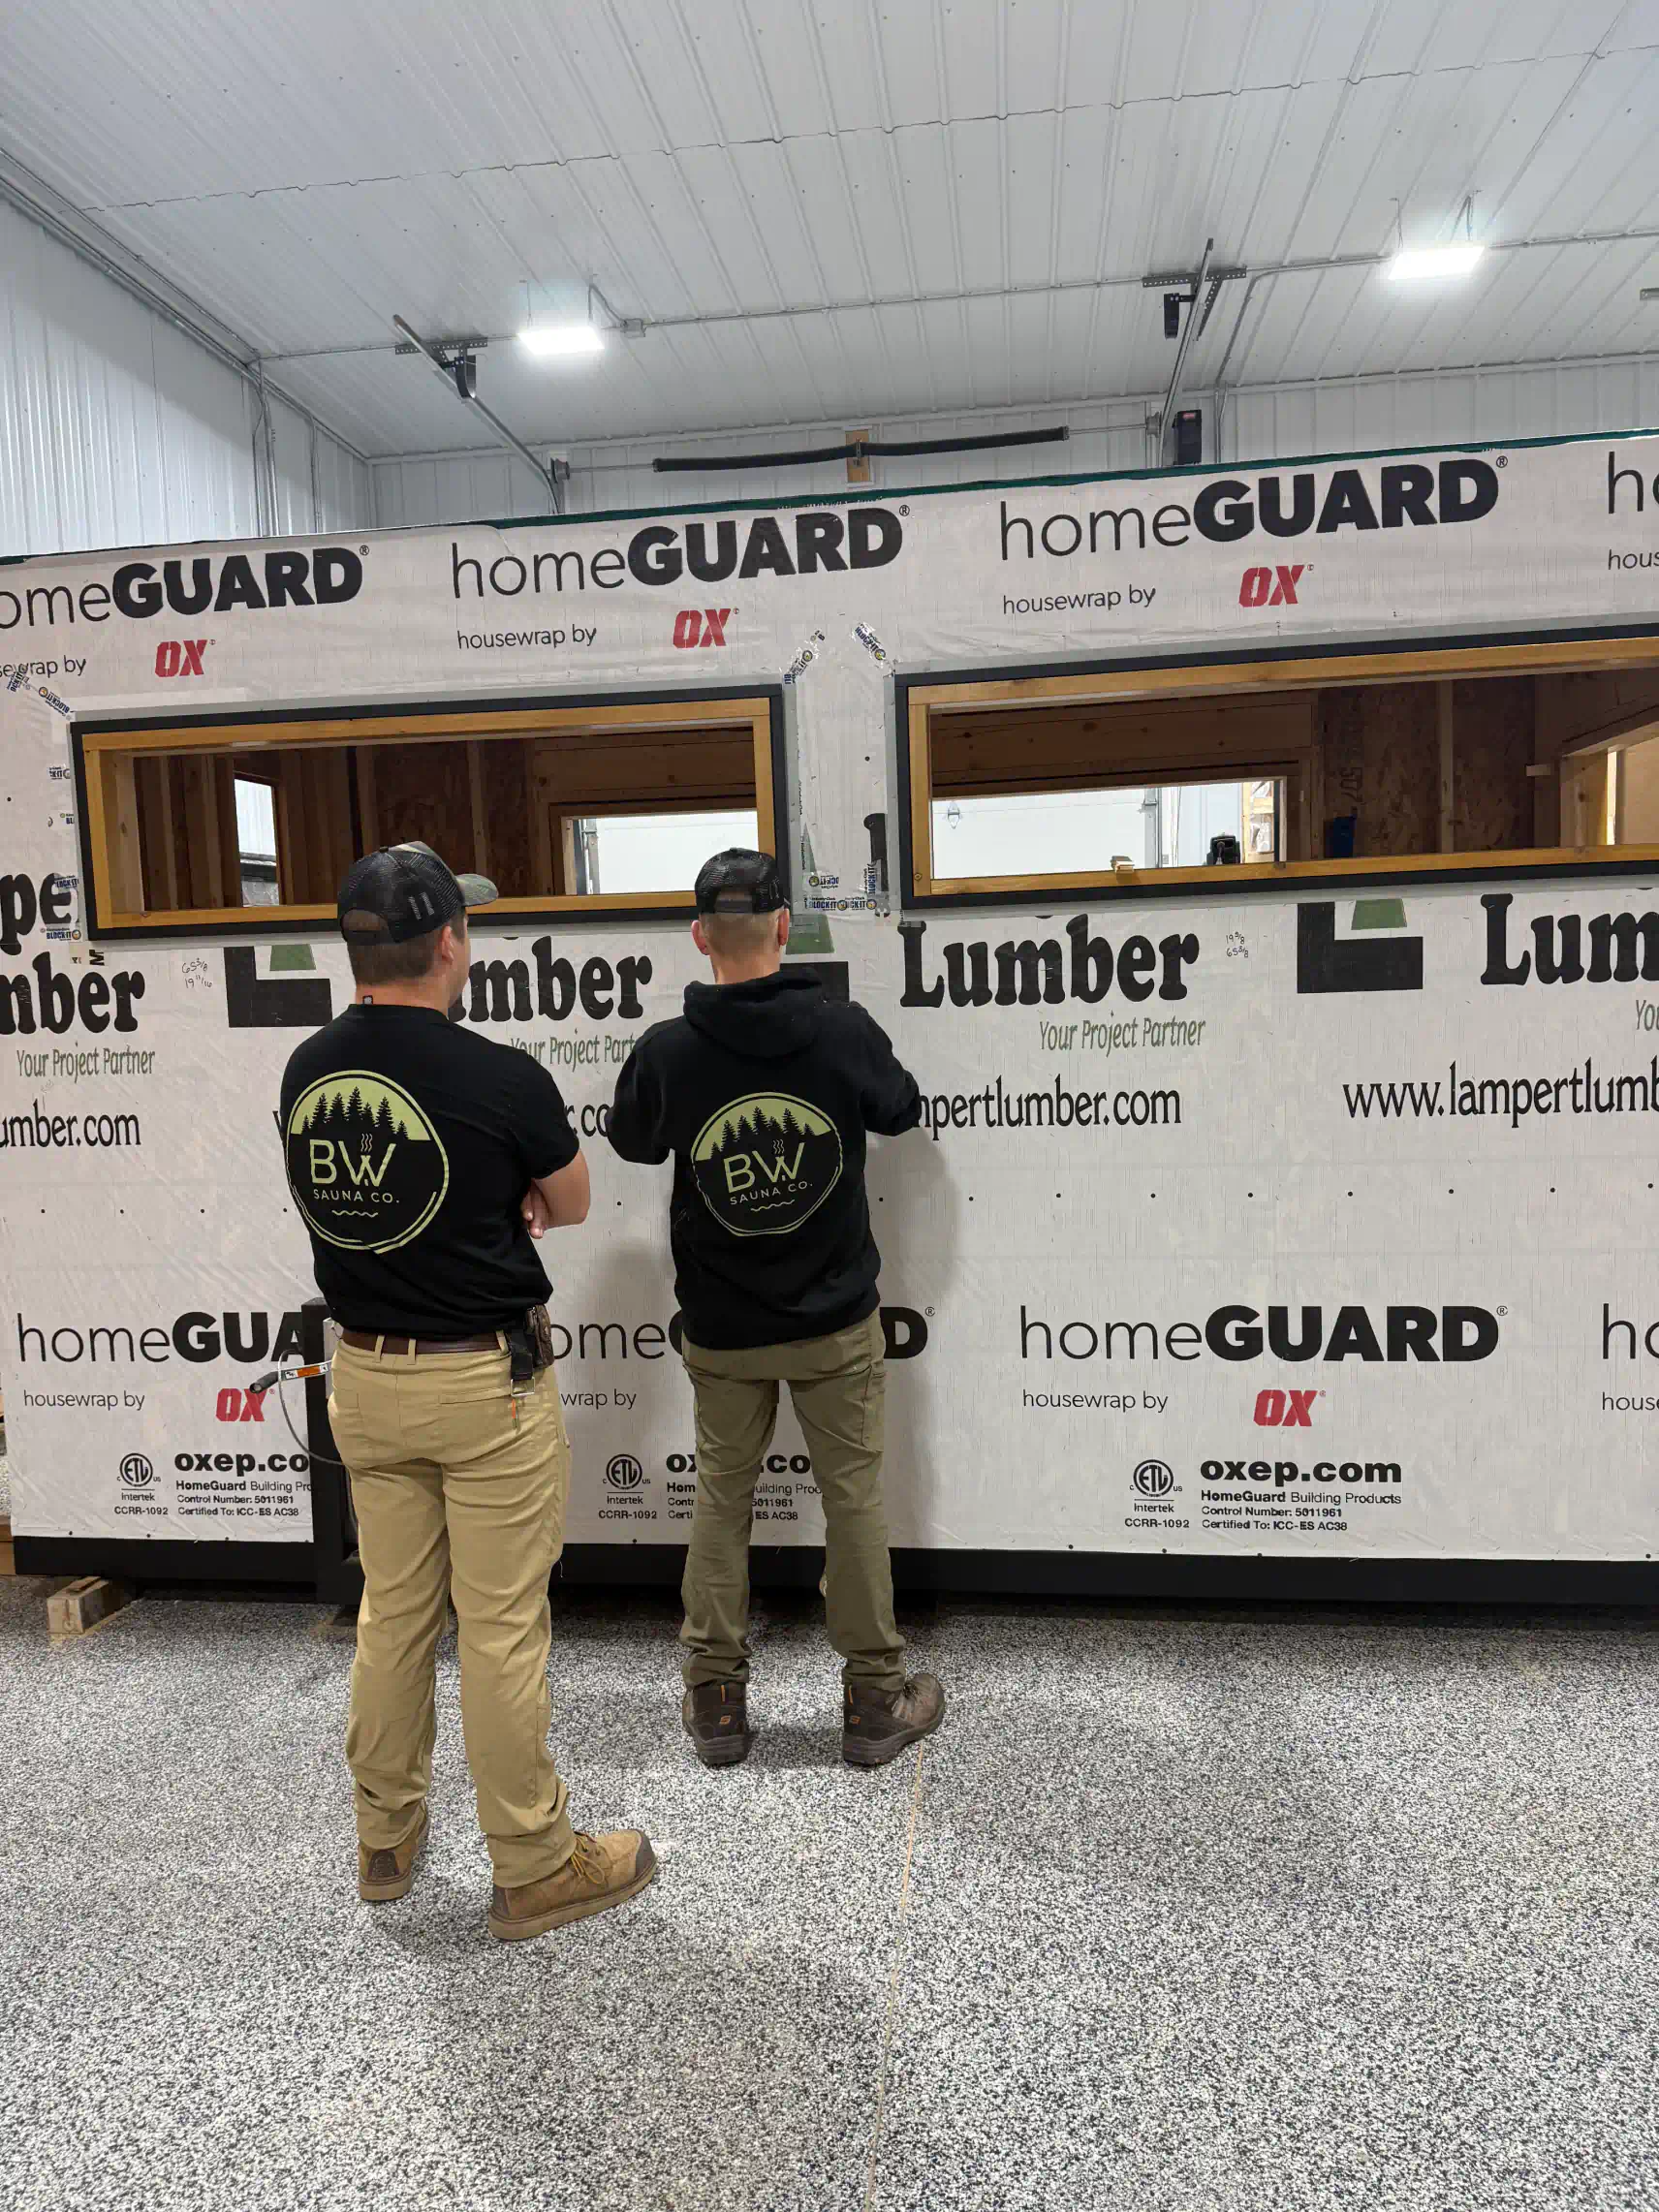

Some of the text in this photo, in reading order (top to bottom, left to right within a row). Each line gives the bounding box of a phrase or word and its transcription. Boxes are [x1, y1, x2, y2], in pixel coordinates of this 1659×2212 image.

[0, 545, 369, 630] omeGUARD®
[1002, 588, 1121, 615] housewrap
[1128, 584, 1156, 608] by
[456, 629, 566, 651] housewrap
[572, 627, 597, 647] by
[63, 654, 87, 676] by
[1480, 893, 1659, 986] Lum
[897, 914, 1200, 1008] Lumber
[449, 936, 653, 1022] mber
[1039, 1010, 1206, 1058] Your Project Partner
[549, 1028, 600, 1072] Project
[604, 1033, 637, 1064] Part
[16, 1041, 155, 1083] Your Project Partner
[313, 1189, 399, 1203] SAUNA CO.
[730, 1181, 813, 1205] SAUNA CO.
[17, 1311, 303, 1362] homeGUA
[23, 1390, 119, 1411] housewrap
[124, 1389, 145, 1412] by
[561, 1388, 637, 1410] wrap by
[1022, 1388, 1136, 1413] housewrap
[1142, 1388, 1169, 1414] by
[174, 1452, 309, 1478] oxep.co
[1200, 1459, 1402, 1487] oxep.com
[121, 1492, 155, 1502] Intertek
[176, 1480, 247, 1491] HomeGuard
[250, 1480, 293, 1494] Building
[667, 1481, 696, 1493] Hom
[754, 1483, 792, 1496] uilding
[1201, 1489, 1401, 1506] HomeGuard Building Products
[114, 1506, 169, 1515] CCRR-1092
[177, 1494, 294, 1505] Control Number: 5011961
[607, 1494, 643, 1505] Intertek
[668, 1497, 694, 1506] Contr
[1134, 1502, 1174, 1513] Intertek
[177, 1507, 299, 1516] Certified To: ICC-ES AC38
[598, 1510, 657, 1520] CCRR-1092
[668, 1510, 693, 1519] Certi
[771, 1511, 798, 1520] AC38
[1202, 1505, 1342, 1518] Control Number: 5011961
[1124, 1517, 1190, 1529] CCRR-1092
[1202, 1519, 1348, 1532] Certified To: ICC-ES AC38
